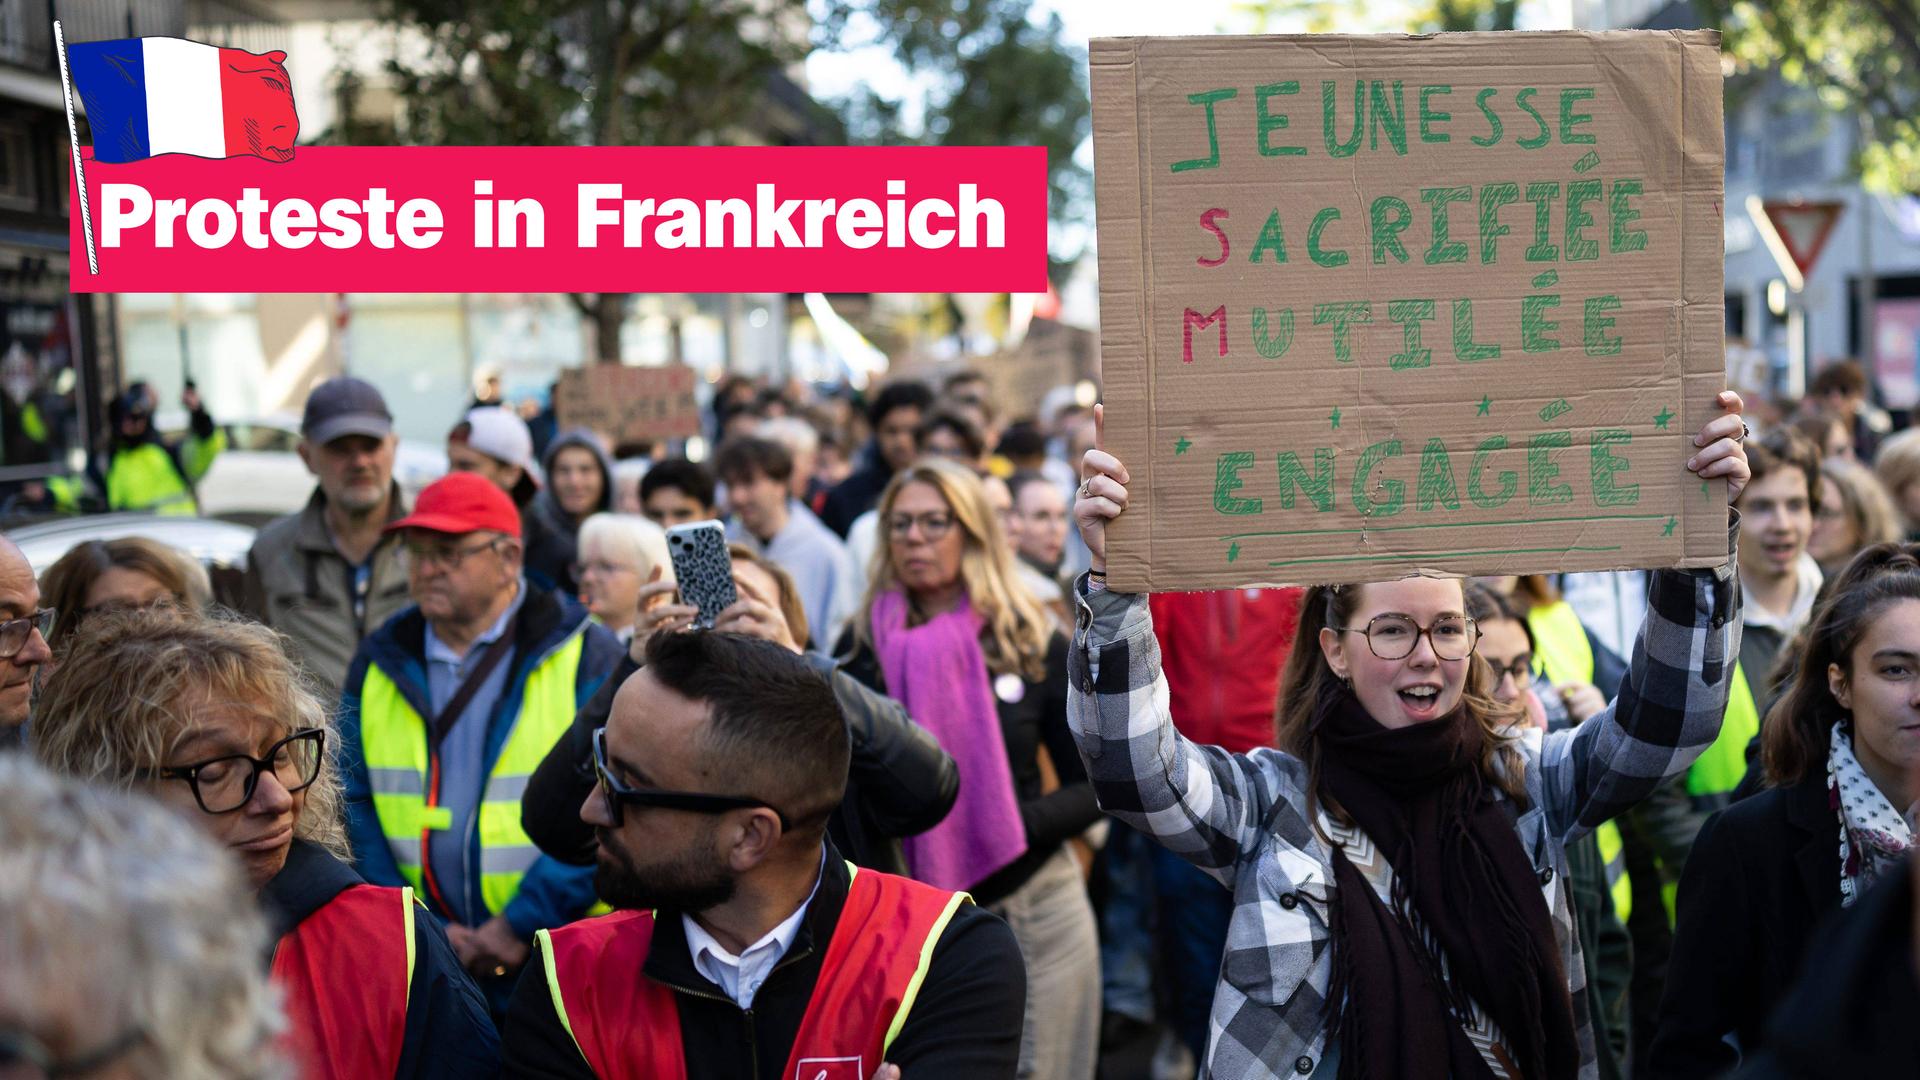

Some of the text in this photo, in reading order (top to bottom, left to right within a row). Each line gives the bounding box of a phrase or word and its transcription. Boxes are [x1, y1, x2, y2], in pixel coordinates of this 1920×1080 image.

[1170, 80, 1597, 173] JEUNESSE
[1197, 151, 1649, 268] SACRIFIÉE
[1182, 269, 1623, 371] MUTILÉE
[1212, 399, 1641, 515] ENGAGÉE
